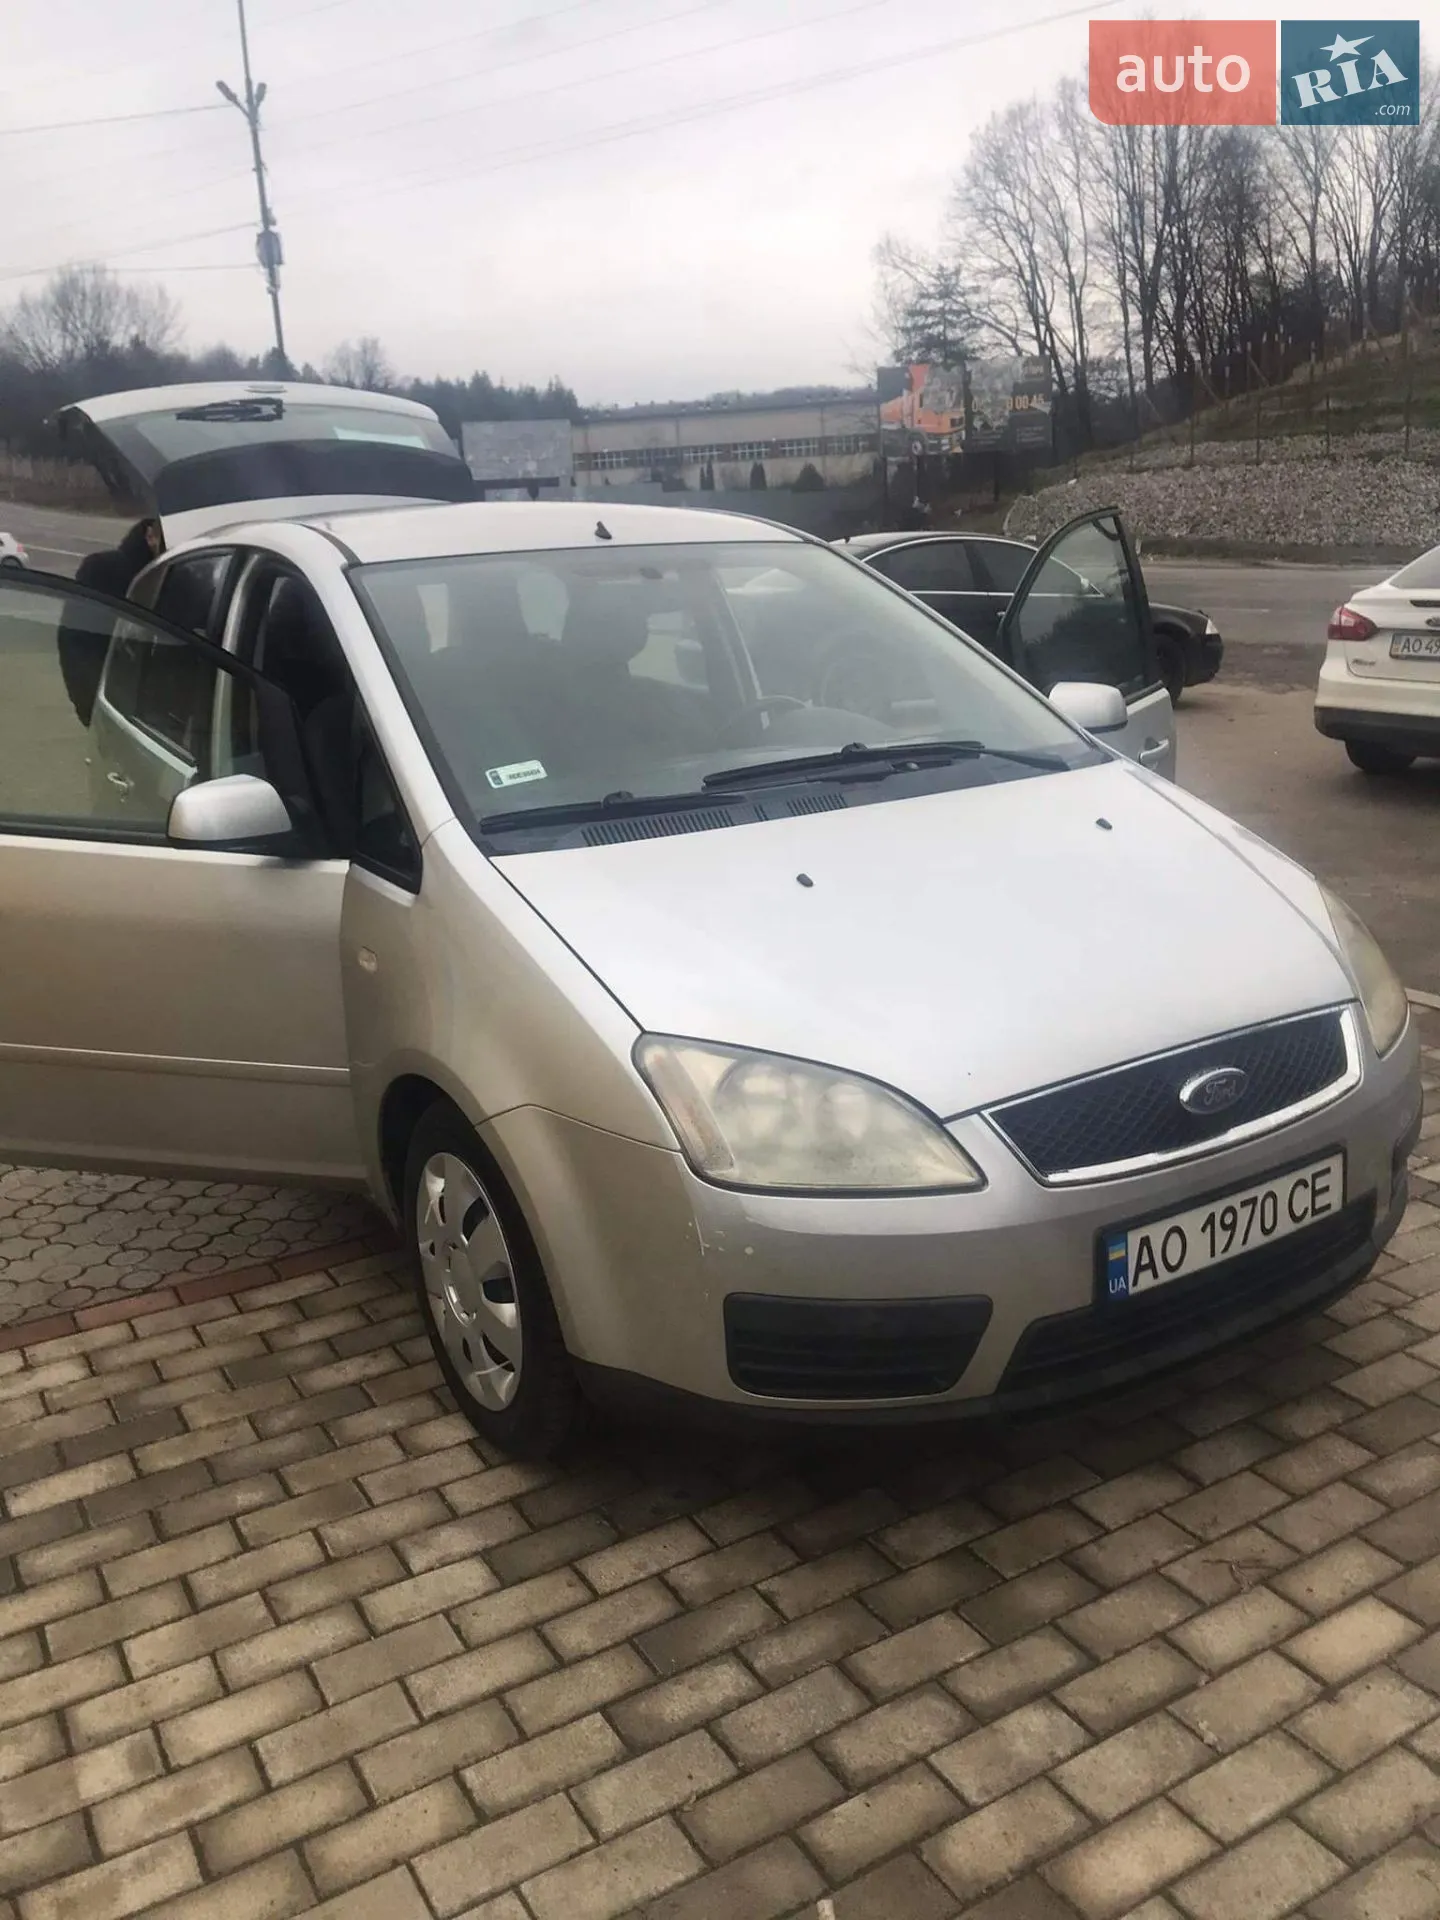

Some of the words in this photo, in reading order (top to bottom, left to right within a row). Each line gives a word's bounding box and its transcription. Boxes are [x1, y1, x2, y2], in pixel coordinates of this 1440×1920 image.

[1400, 637, 1423, 654] AO
[1131, 1225, 1187, 1288] AO
[1200, 1190, 1278, 1259] 1970
[1288, 1166, 1332, 1224] CE
[1109, 1275, 1127, 1294] UA
